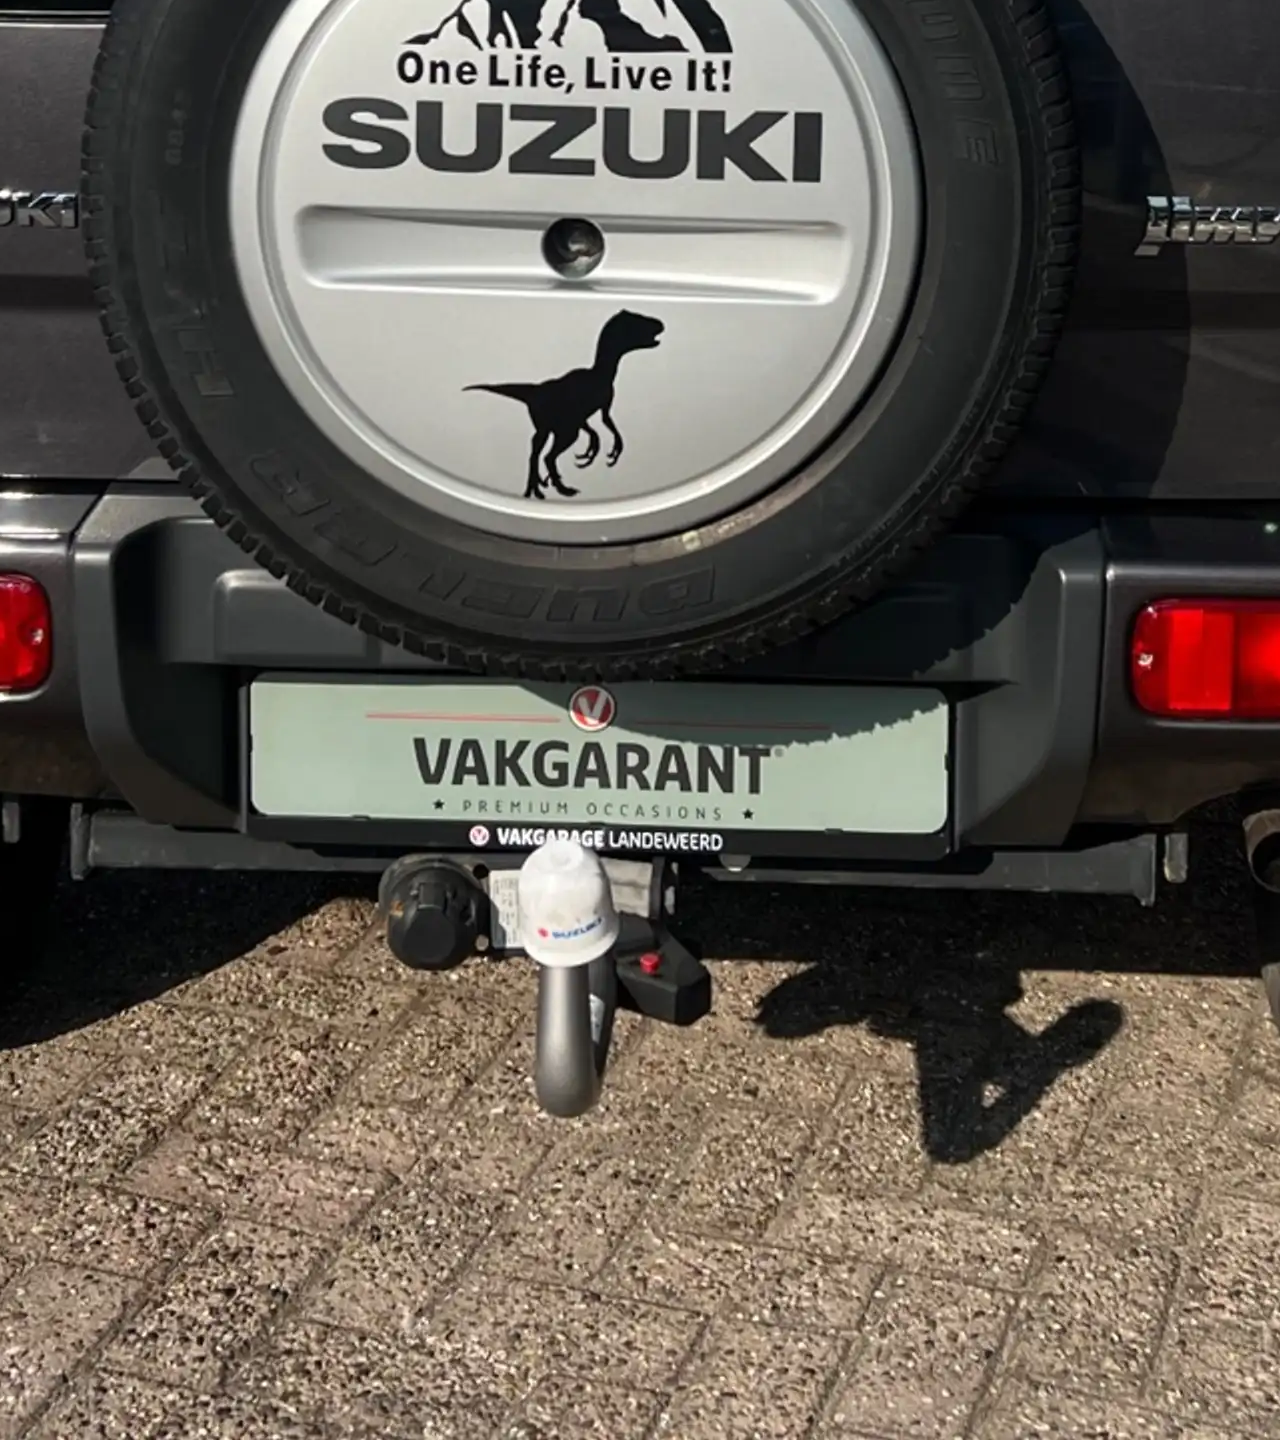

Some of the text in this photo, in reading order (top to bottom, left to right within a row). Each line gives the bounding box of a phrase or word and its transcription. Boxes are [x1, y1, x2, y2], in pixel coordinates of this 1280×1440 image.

[396, 51, 732, 94] One Life, Live It!
[319, 96, 823, 183] SUZUKI
[413, 738, 772, 795] VAKGARANT
[463, 799, 722, 821] PREMIUM OCCASIONS
[609, 831, 723, 852] LANDEWEERD
